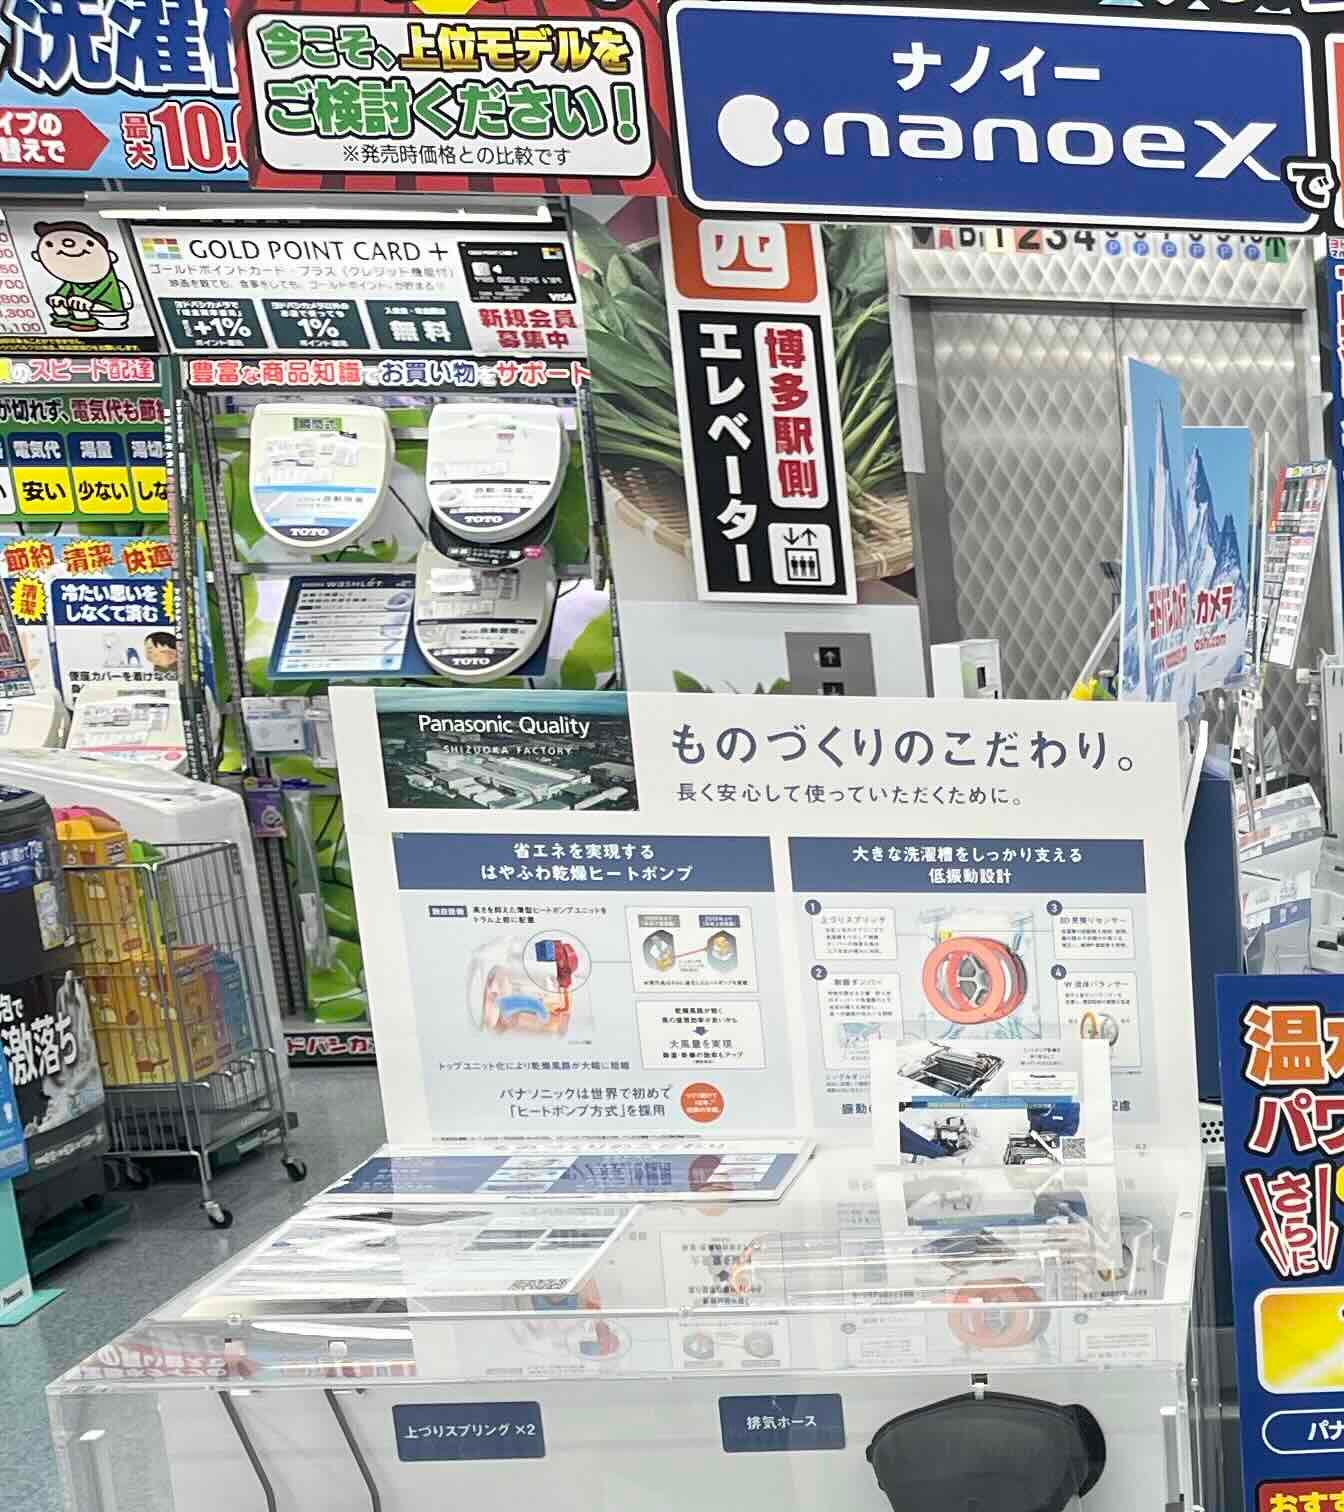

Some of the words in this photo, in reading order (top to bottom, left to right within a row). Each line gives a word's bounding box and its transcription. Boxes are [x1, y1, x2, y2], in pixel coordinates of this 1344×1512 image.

[259, 21, 633, 73] 今こそ、上位モデルを
[893, 42, 1100, 96] ナノイー
[343, 143, 571, 167] ※発売時価格との比較です
[1289, 164, 1334, 208] で
[190, 240, 260, 259] GOLD
[271, 241, 344, 260] POINT
[354, 242, 421, 261] CARD
[479, 309, 578, 330] 新規会員
[497, 331, 570, 349] 募集中
[764, 328, 818, 498] 博多駅側
[699, 324, 757, 583] エレベーター
[22, 480, 67, 501] 安い
[77, 480, 129, 501] 少ない
[464, 515, 504, 524] TOTO
[289, 527, 329, 538] TOTO
[6, 544, 54, 572] 節約
[62, 584, 158, 602] 冷たい思いを
[67, 605, 158, 622] しなくて済む
[419, 715, 505, 733] Panasonic
[519, 717, 590, 738] Quality
[672, 725, 1134, 773] ものづくりのこだわり。
[677, 784, 1023, 806] 長く安心して使っていただくために。
[514, 844, 655, 860] 省エネを実現する
[853, 847, 1082, 863] 大きな洗濯槽をしっかり支える
[482, 864, 693, 882] はやふわ乾燥ヒートポンプ
[928, 869, 1013, 884] 低振動設計
[1271, 1173, 1319, 1274] さらに
[746, 1414, 818, 1430] 排気ホース
